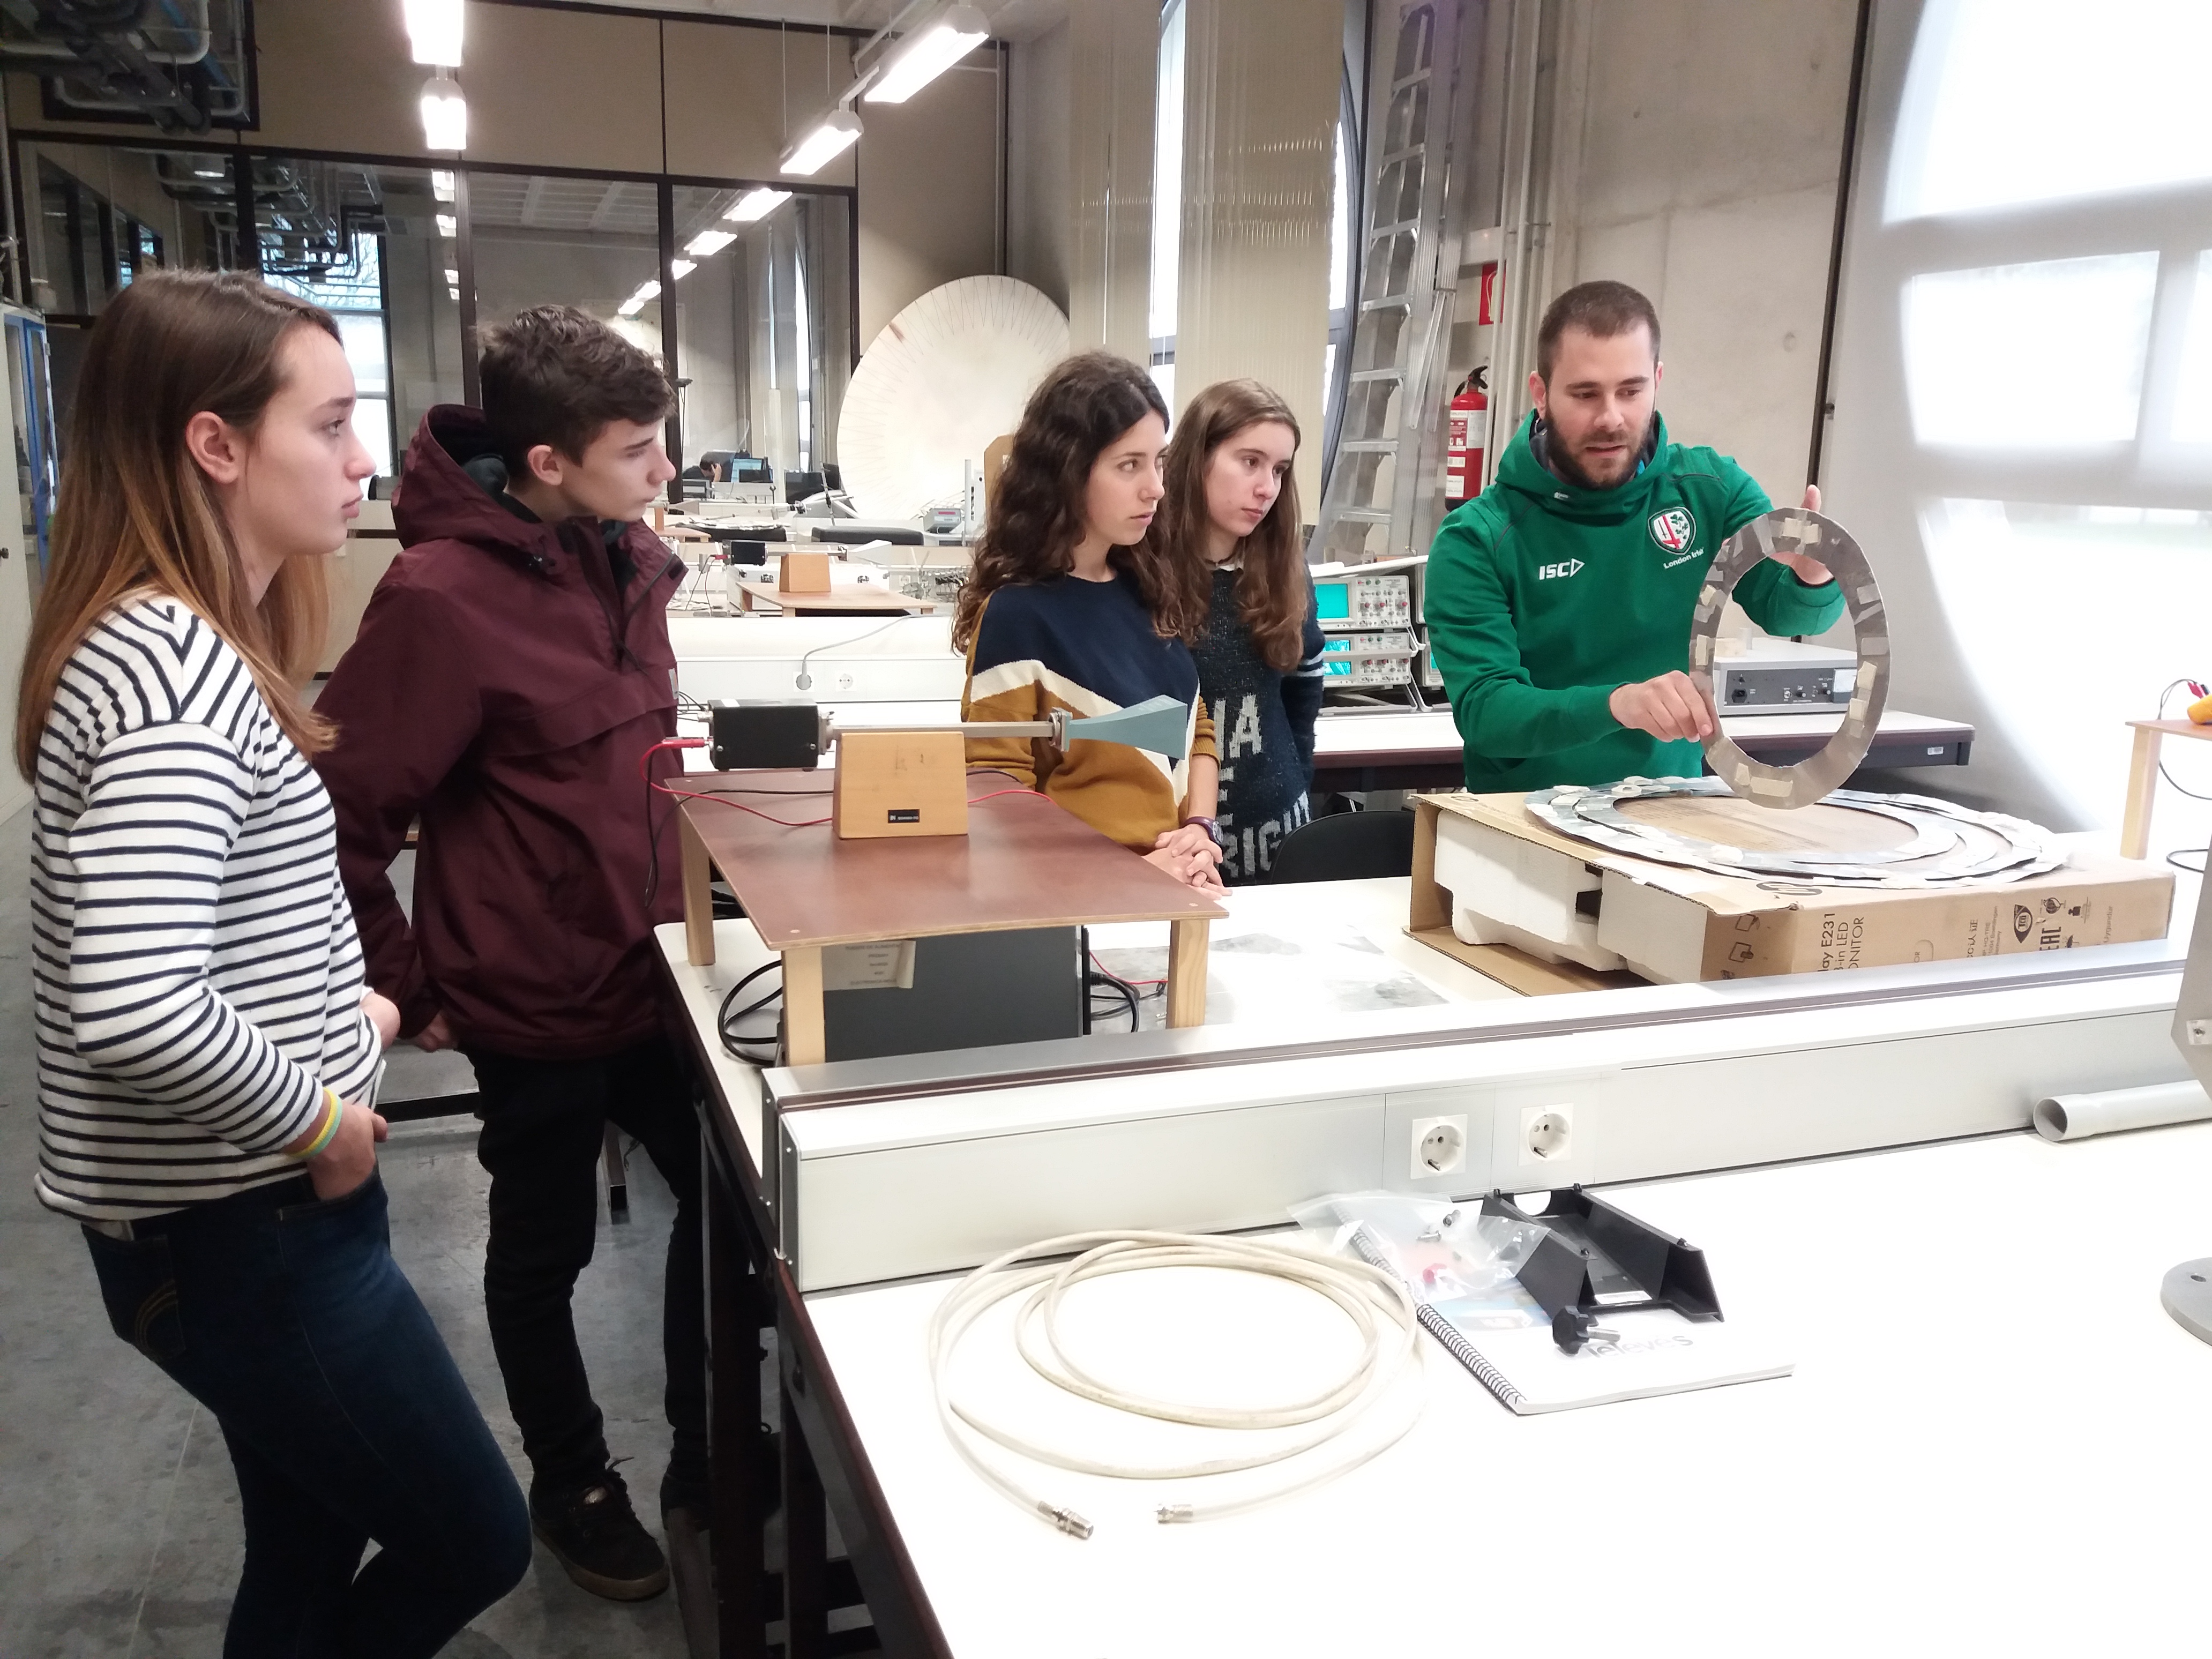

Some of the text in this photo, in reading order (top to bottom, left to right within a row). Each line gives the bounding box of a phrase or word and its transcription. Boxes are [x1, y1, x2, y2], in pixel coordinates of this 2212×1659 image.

[1663, 554, 1692, 569] London
[1821, 913, 1835, 947] E231
[1836, 922, 1849, 946] LED
